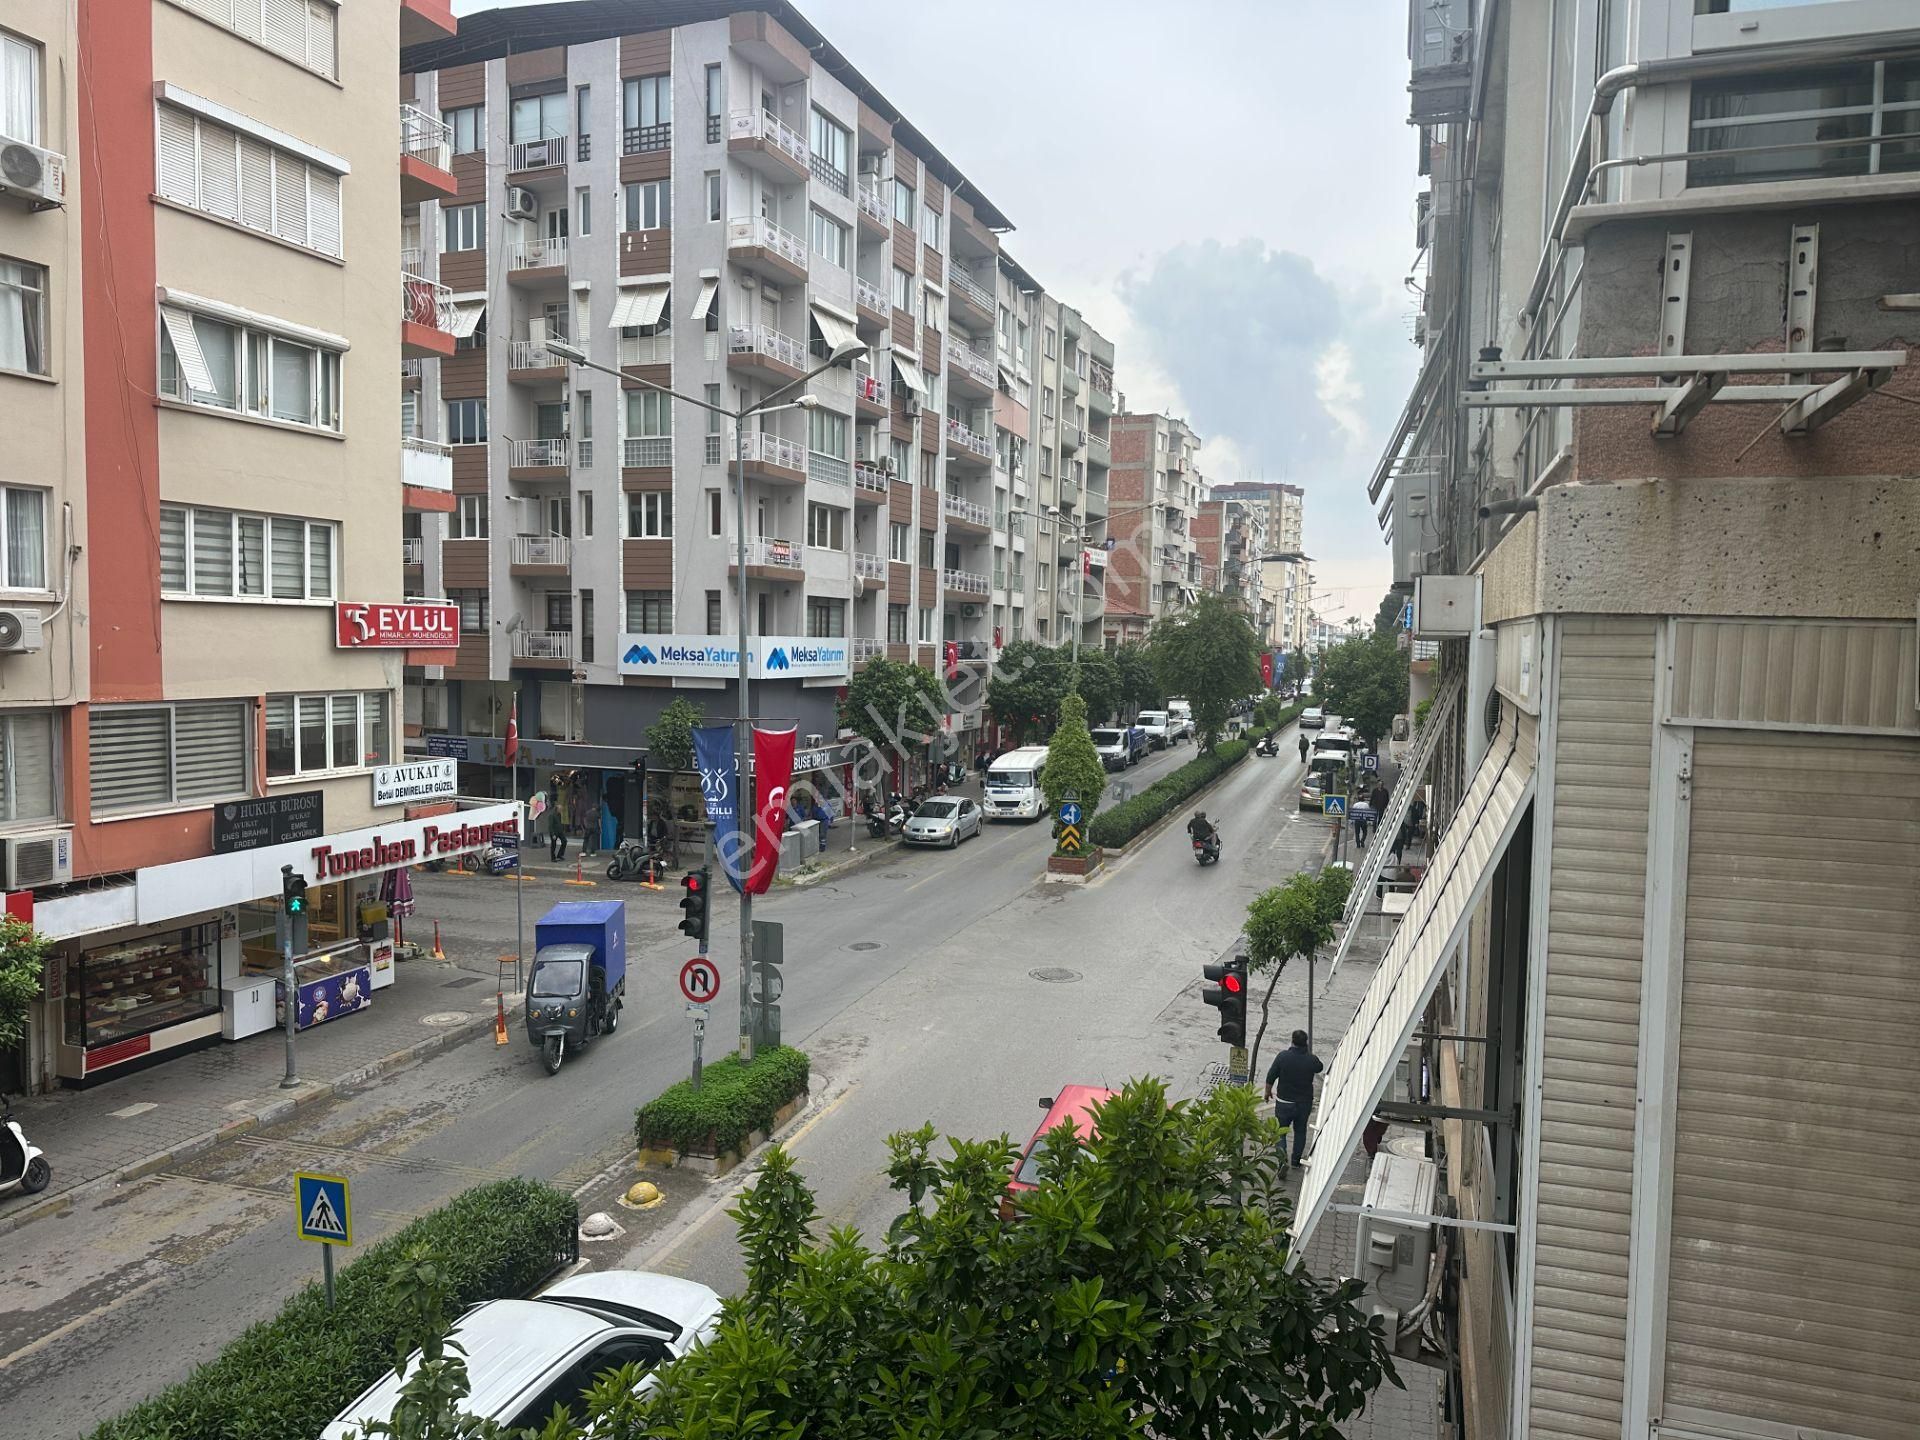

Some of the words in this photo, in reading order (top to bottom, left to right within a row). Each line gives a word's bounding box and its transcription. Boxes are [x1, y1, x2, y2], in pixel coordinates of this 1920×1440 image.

[379, 608, 453, 631] EYLÜL
[793, 756, 811, 771] BUSE
[812, 750, 831, 767] OPTİK
[394, 764, 440, 783] AVUKAT
[434, 779, 454, 792] GÜZEL
[240, 801, 277, 819] HUKUK
[280, 795, 319, 813] BÜROSU
[233, 820, 259, 830] AVUKAT
[291, 820, 308, 831] EMRE
[222, 831, 240, 842] ENES
[234, 838, 257, 849] ERDEM
[311, 835, 416, 879] Tunahan
[423, 811, 519, 856] Pastanesi
